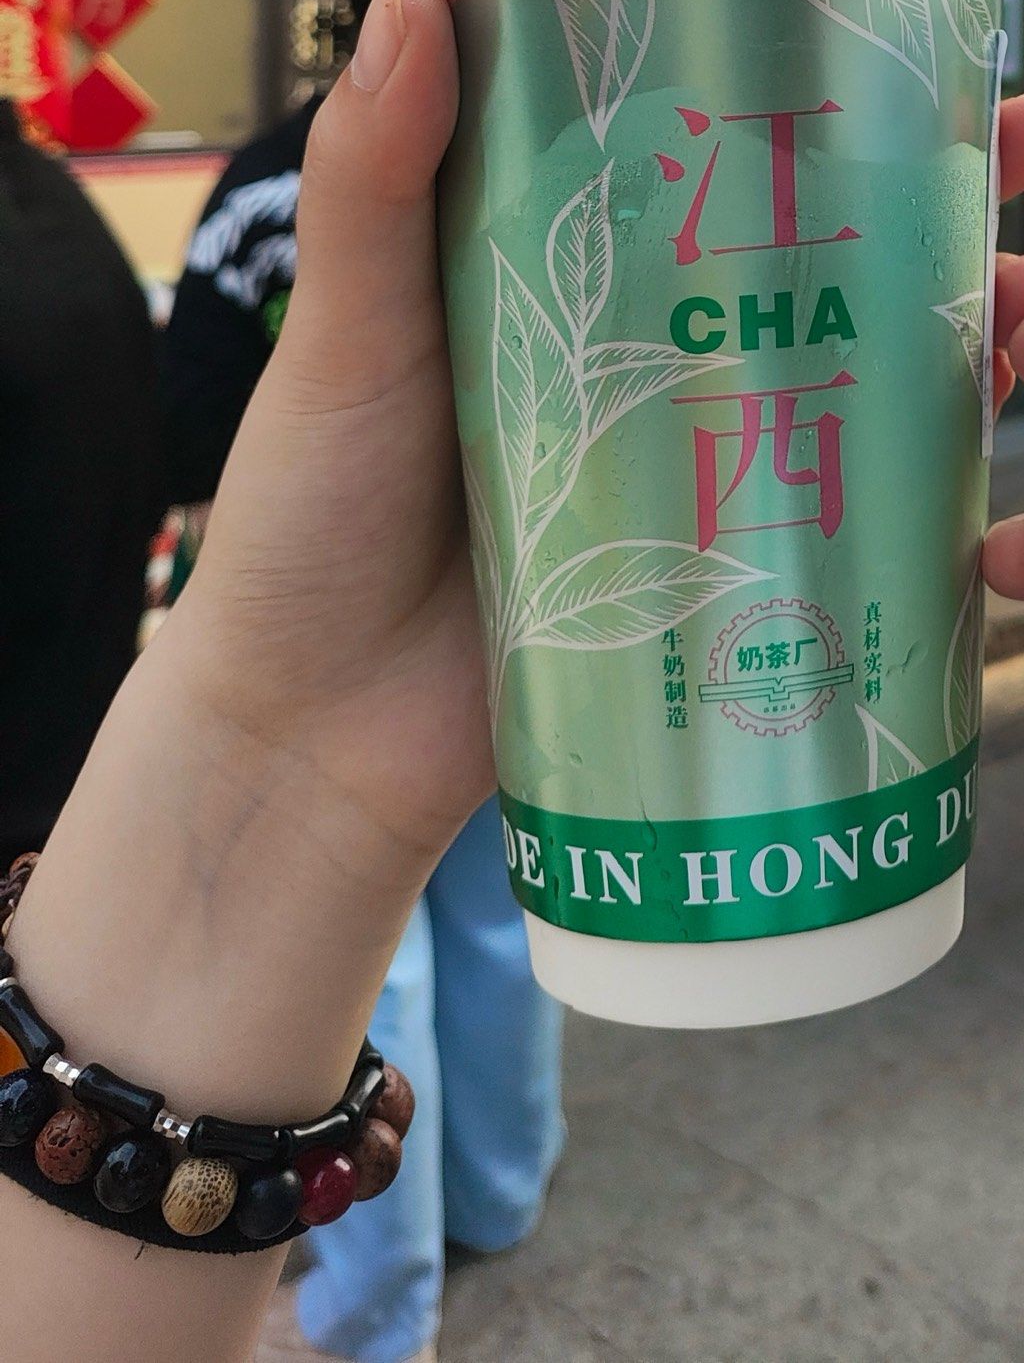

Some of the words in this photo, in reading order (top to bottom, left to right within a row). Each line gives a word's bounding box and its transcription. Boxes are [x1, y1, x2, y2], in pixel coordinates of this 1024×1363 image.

[654, 99, 863, 266] 江
[669, 285, 859, 356] CHA
[670, 369, 860, 554] 西
[661, 627, 690, 730] 牛奶制造
[736, 637, 818, 672] 奶茶厂
[863, 600, 883, 705] 真材实料
[564, 844, 644, 906] IN
[679, 811, 914, 907] HONG
[935, 760, 978, 848] DU
